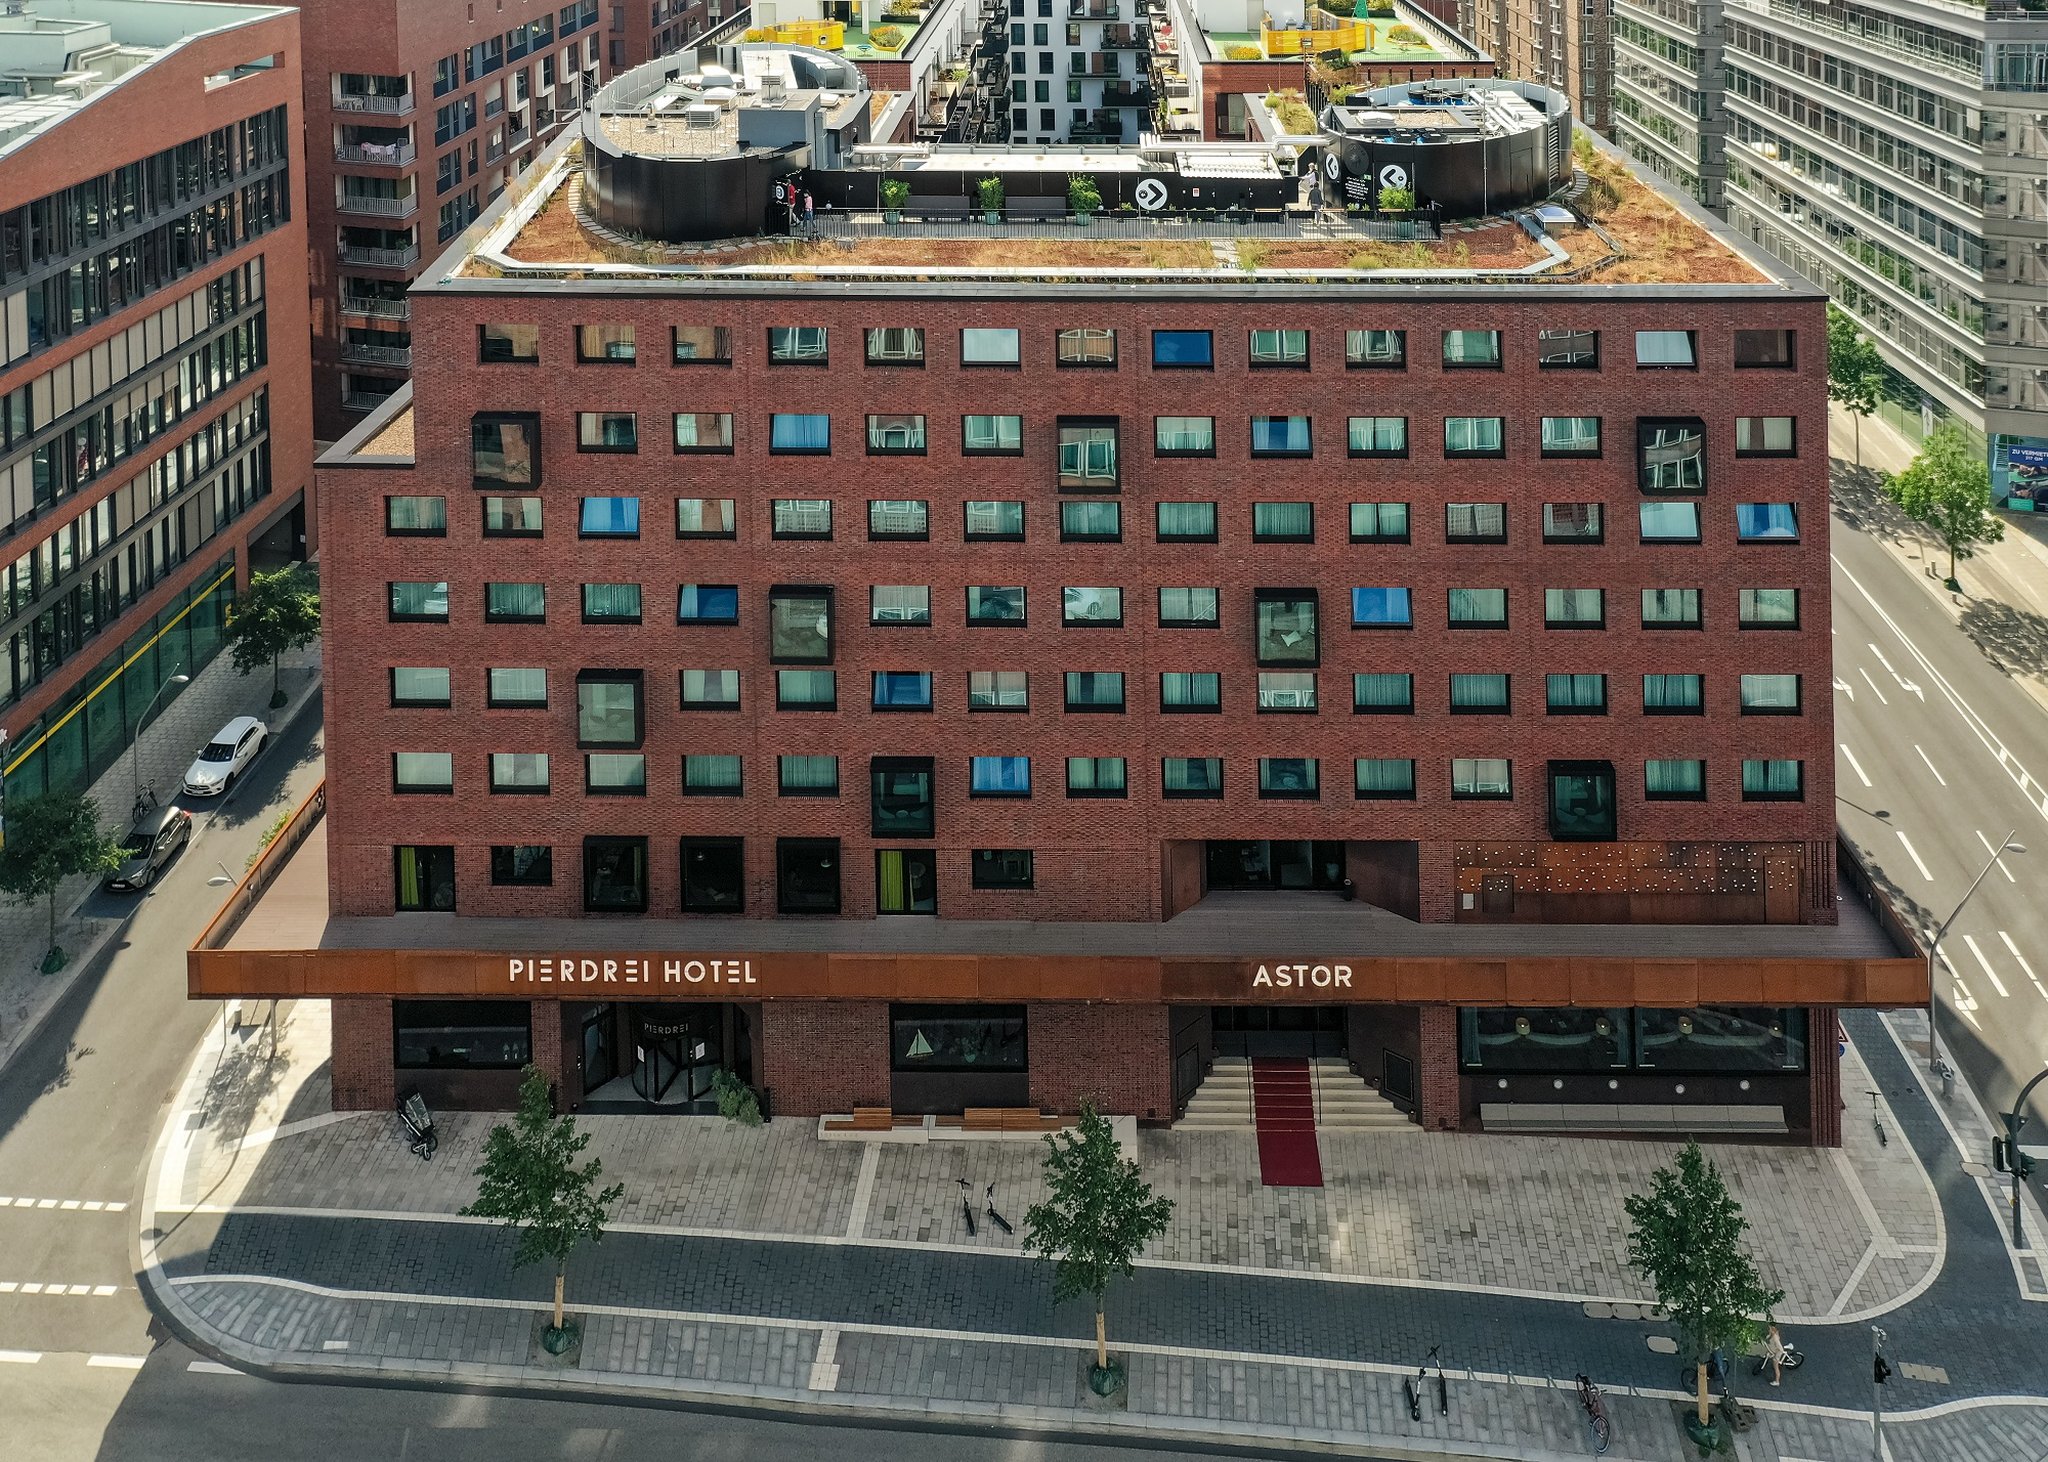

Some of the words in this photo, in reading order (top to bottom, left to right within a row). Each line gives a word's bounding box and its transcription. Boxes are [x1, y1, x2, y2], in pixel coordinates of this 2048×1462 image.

[509, 959, 649, 983] PIERDREI
[664, 960, 757, 984] HOTEL
[1252, 964, 1353, 988] ASTOR
[644, 1022, 689, 1035] PIERDREI
